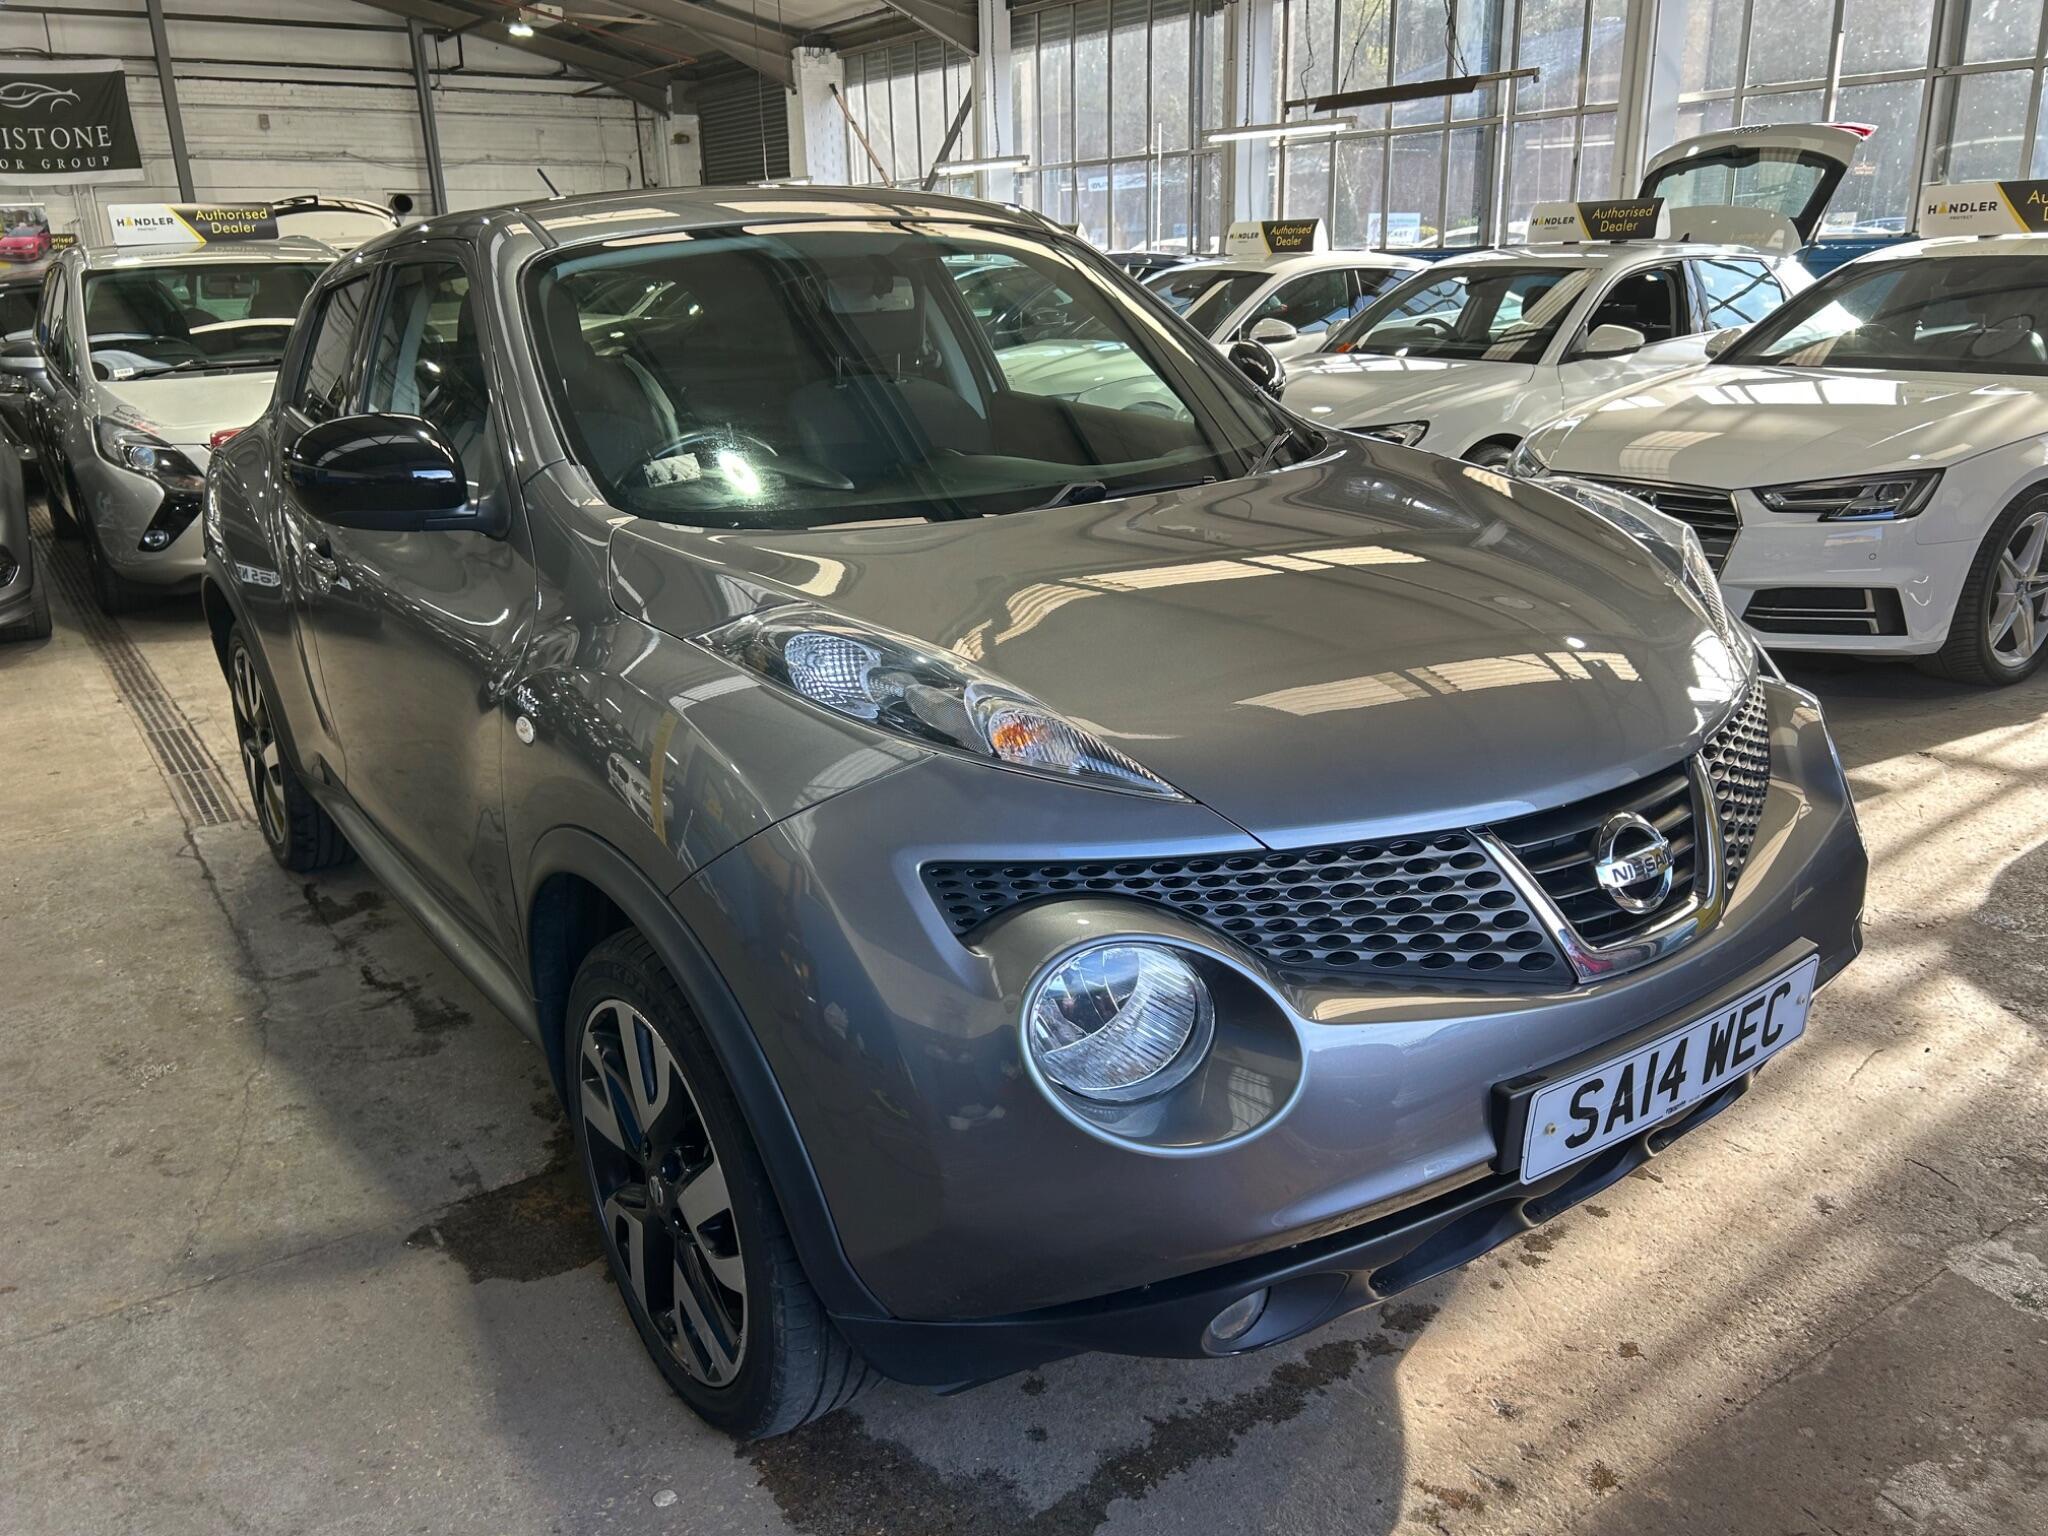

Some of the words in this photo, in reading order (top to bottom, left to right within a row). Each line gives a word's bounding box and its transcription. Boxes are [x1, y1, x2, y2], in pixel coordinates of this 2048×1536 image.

[1, 125, 112, 150] ISTONE
[41, 155, 110, 169] GROUP
[1592, 204, 1655, 219] Authorised
[1927, 201, 1998, 214] HANDLER
[195, 207, 268, 222] Authorised
[1531, 216, 1575, 226] HANDLER
[116, 216, 174, 227] HANDLER
[211, 222, 257, 234] Dealer
[1600, 220, 1639, 232] Dealer
[1270, 223, 1313, 235] Authorised
[1275, 236, 1302, 246] Dealer
[1611, 845, 1674, 883] NISSAN
[1564, 1036, 1689, 1149] SA14
[1702, 981, 1791, 1085] WEC
